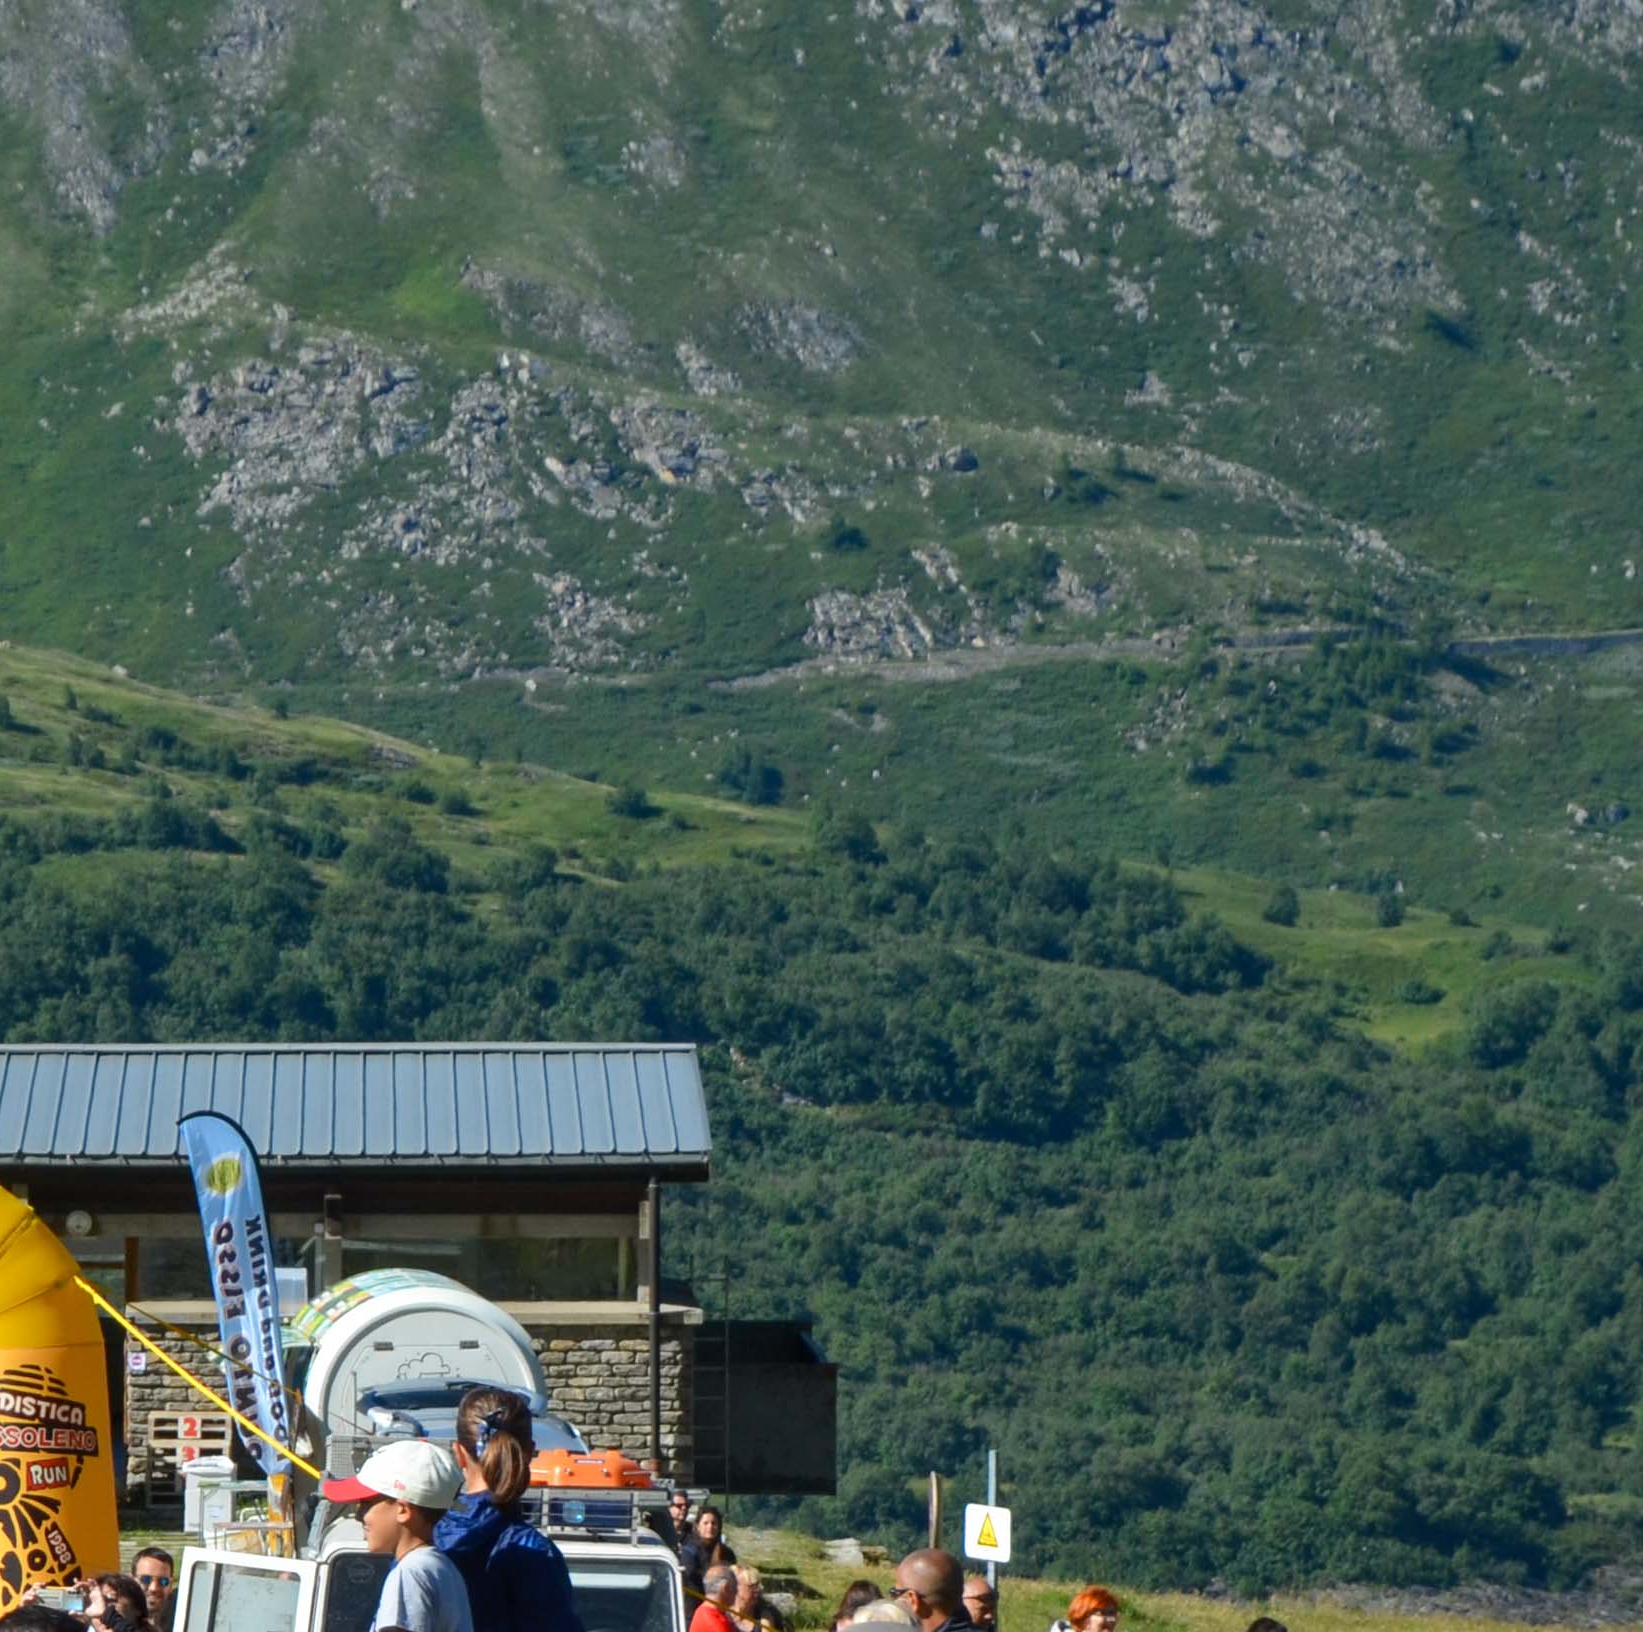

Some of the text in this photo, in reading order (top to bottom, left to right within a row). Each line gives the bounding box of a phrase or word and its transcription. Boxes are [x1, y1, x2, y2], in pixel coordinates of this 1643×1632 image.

[182, 1417, 198, 1437] 2
[182, 1447, 198, 1461] 3
[30, 1464, 67, 1485] RUN
[47, 1529, 72, 1565] 1988
